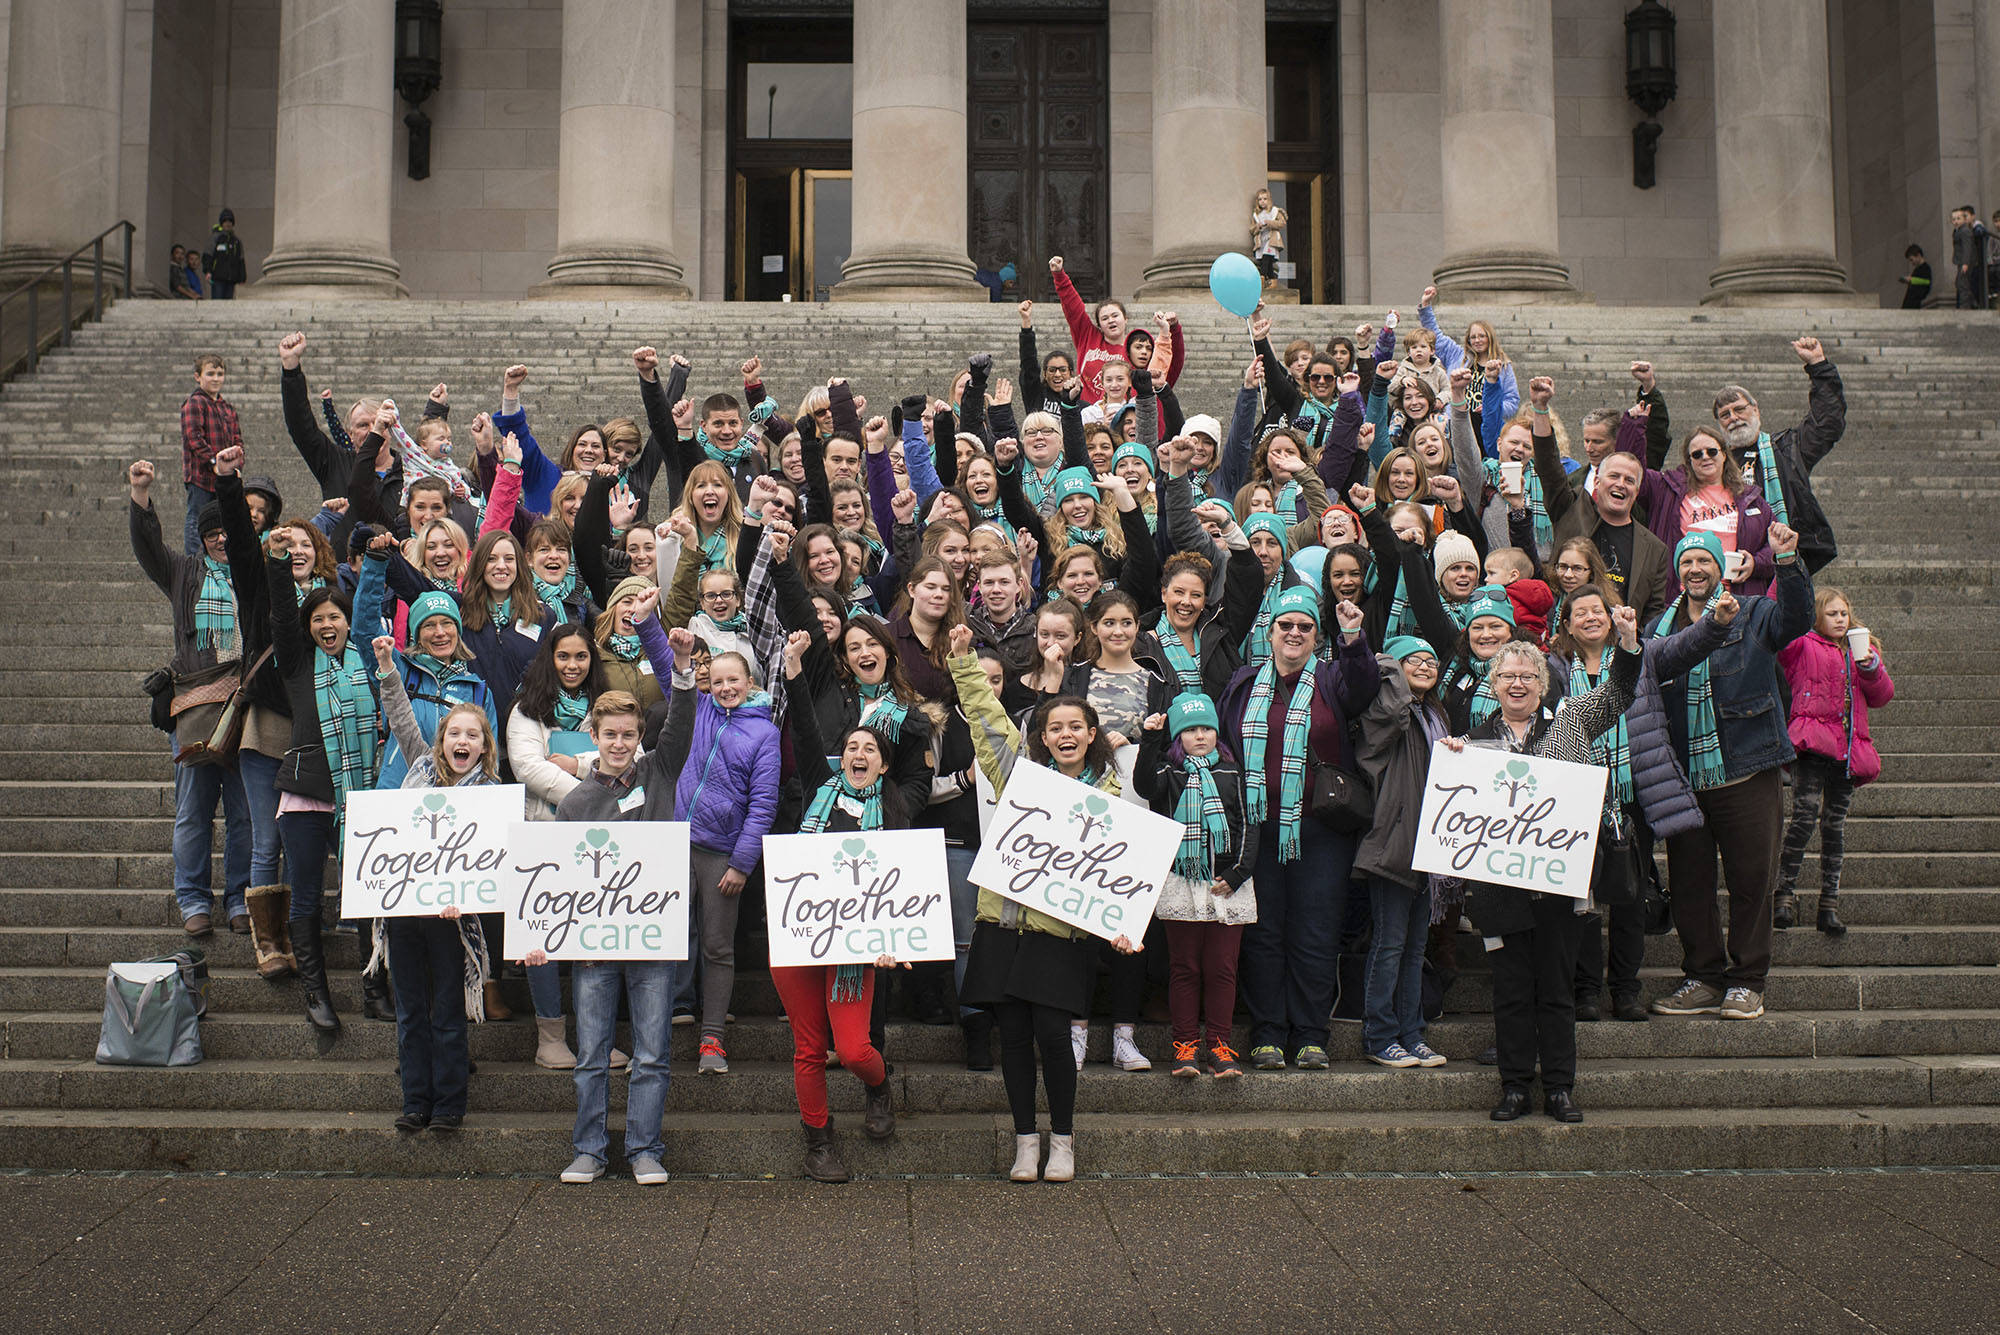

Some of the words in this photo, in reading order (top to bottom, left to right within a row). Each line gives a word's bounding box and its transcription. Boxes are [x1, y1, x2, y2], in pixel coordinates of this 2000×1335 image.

[1431, 783, 1589, 870] Together
[995, 799, 1153, 899] Together
[1438, 835, 1459, 848] WE
[353, 822, 507, 910] Together
[1001, 852, 1022, 870] WE
[1486, 850, 1566, 885] care
[364, 880, 386, 890] WE
[415, 878, 497, 907] care
[514, 861, 680, 953] Together
[774, 867, 941, 959] Together
[1043, 879, 1123, 932] care
[527, 920, 549, 931] WE
[579, 922, 662, 951] care
[791, 927, 813, 938] WE
[845, 926, 928, 955] care
